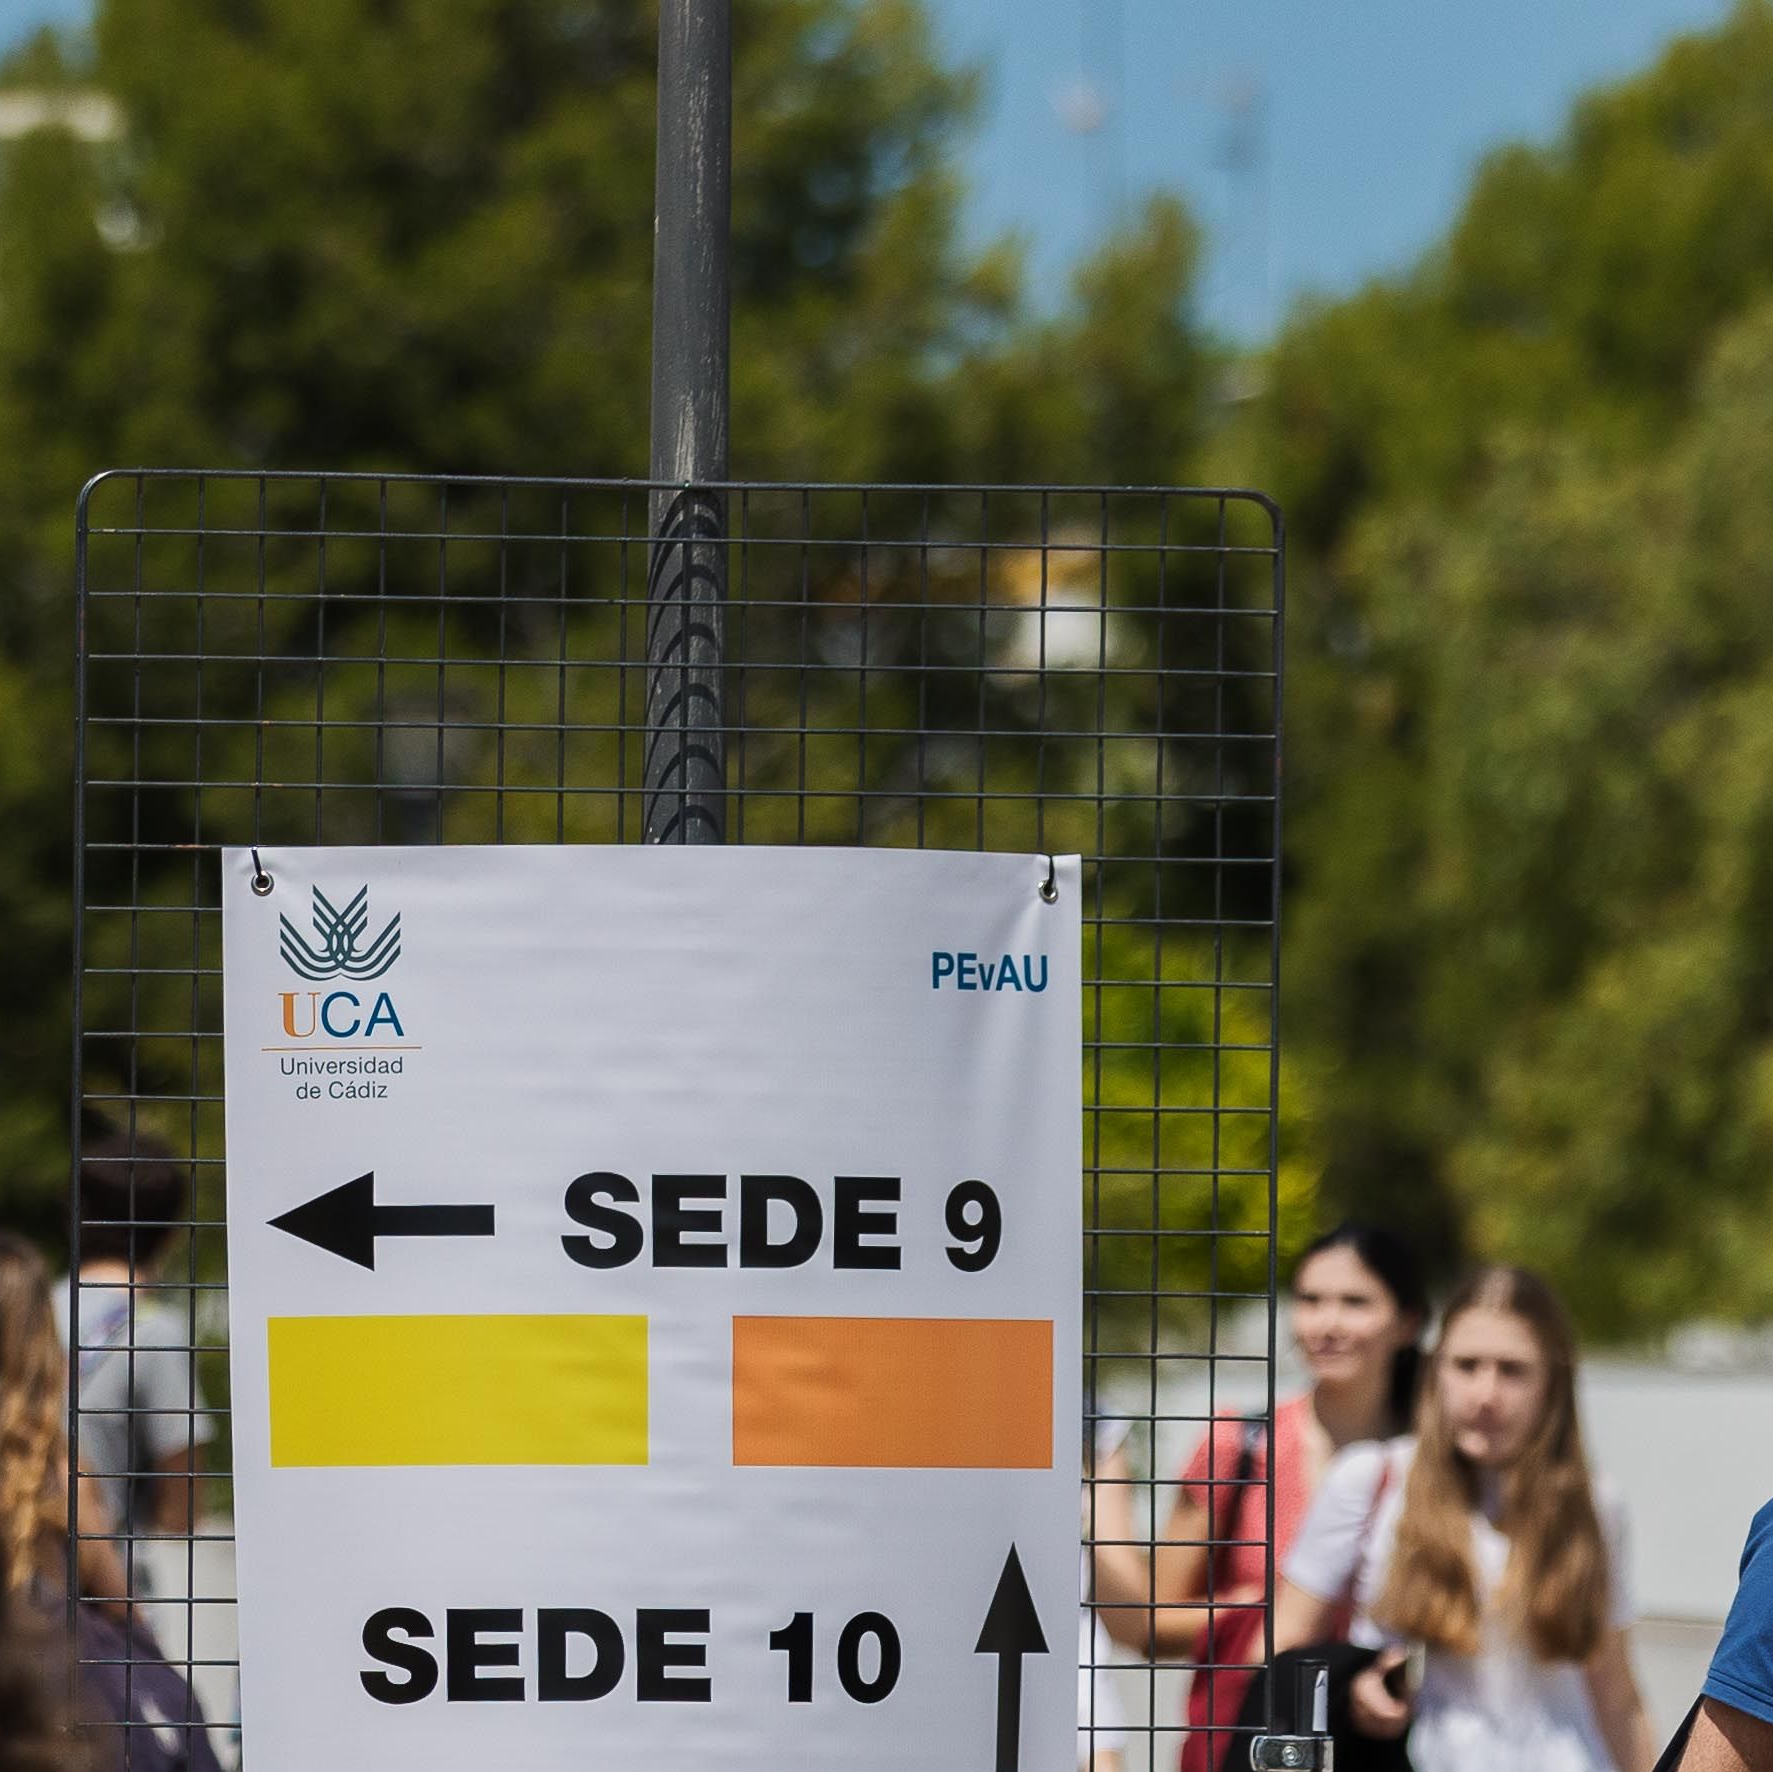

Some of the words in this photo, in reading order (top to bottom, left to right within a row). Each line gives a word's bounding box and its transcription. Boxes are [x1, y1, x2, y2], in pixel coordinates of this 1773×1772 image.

[931, 951, 1049, 993] PEvAU
[277, 991, 405, 1038] UCA
[280, 1056, 403, 1076] Universidad
[295, 1081, 321, 1100] de
[328, 1080, 388, 1100] Cádiz
[560, 1170, 903, 1273] SEDE
[944, 1179, 1003, 1273] 9
[360, 1607, 713, 1706] SEDE
[769, 1611, 902, 1705] 10
